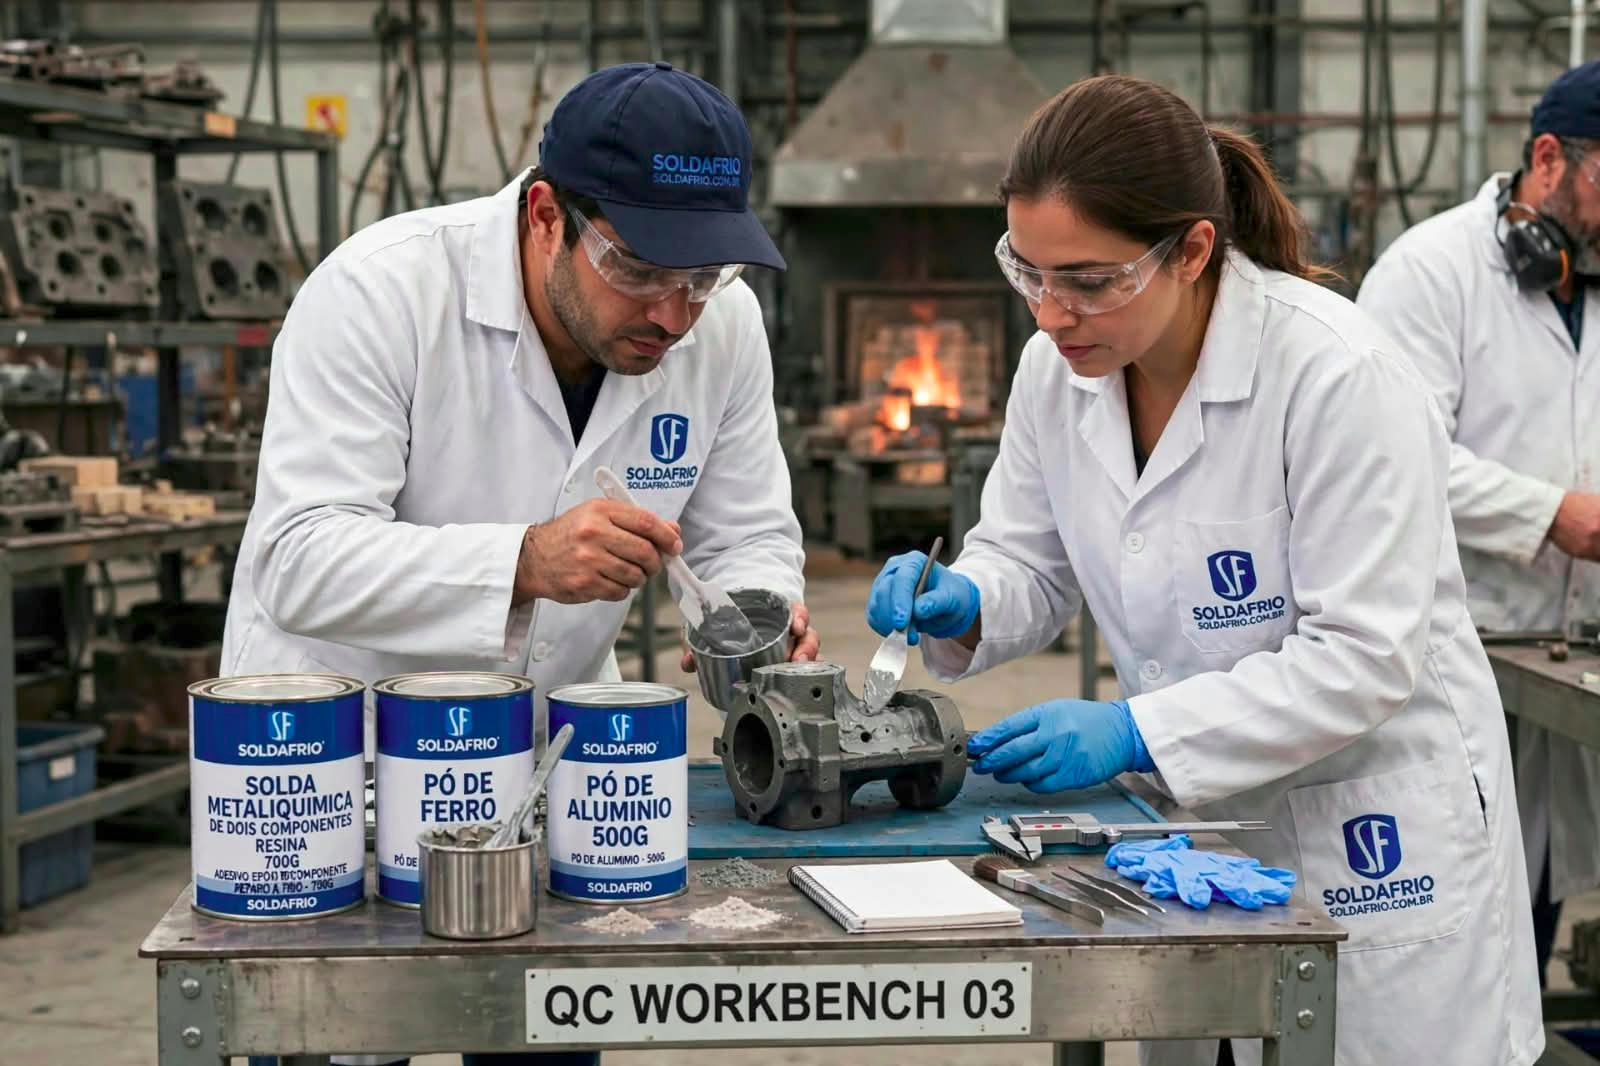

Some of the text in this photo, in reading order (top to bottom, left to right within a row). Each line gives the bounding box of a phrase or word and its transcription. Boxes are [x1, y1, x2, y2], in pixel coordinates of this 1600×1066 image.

[652, 154, 741, 175] SOLDAFRIO
[626, 466, 697, 480] SOLDAFRIO
[1193, 596, 1285, 620] SOLDAFRIO
[1198, 610, 1284, 630] SOLDAFRIO.COM.BR
[239, 741, 323, 757] SOLDAFRIO
[417, 738, 498, 752] SOLDAFRIO
[582, 742, 657, 755] SOLDAFRIO
[246, 774, 316, 795] SOLDA
[424, 768, 493, 795] PÓ DE
[587, 771, 653, 797] PÓ DE
[208, 791, 353, 820] METALIQUIMICA
[421, 798, 496, 822] FERRO
[568, 797, 671, 822] ALUMINIO
[210, 814, 352, 835] DE DOIS COMPONENTES
[256, 838, 308, 852] RESINA
[592, 825, 648, 847] 500G
[265, 854, 300, 868] 700G
[394, 853, 417, 867] PÓ DE
[584, 855, 595, 864] DE
[647, 852, 665, 863] 500G
[272, 883, 279, 893] A
[587, 881, 652, 893] SOLDAFRIO
[1323, 875, 1434, 906] SOLDAFRIO
[247, 897, 317, 910] SOLDAFRIO
[1329, 895, 1434, 917] SOLDAFRIO.COM.BR
[545, 979, 1015, 1029] QC WORKBENCH 03
